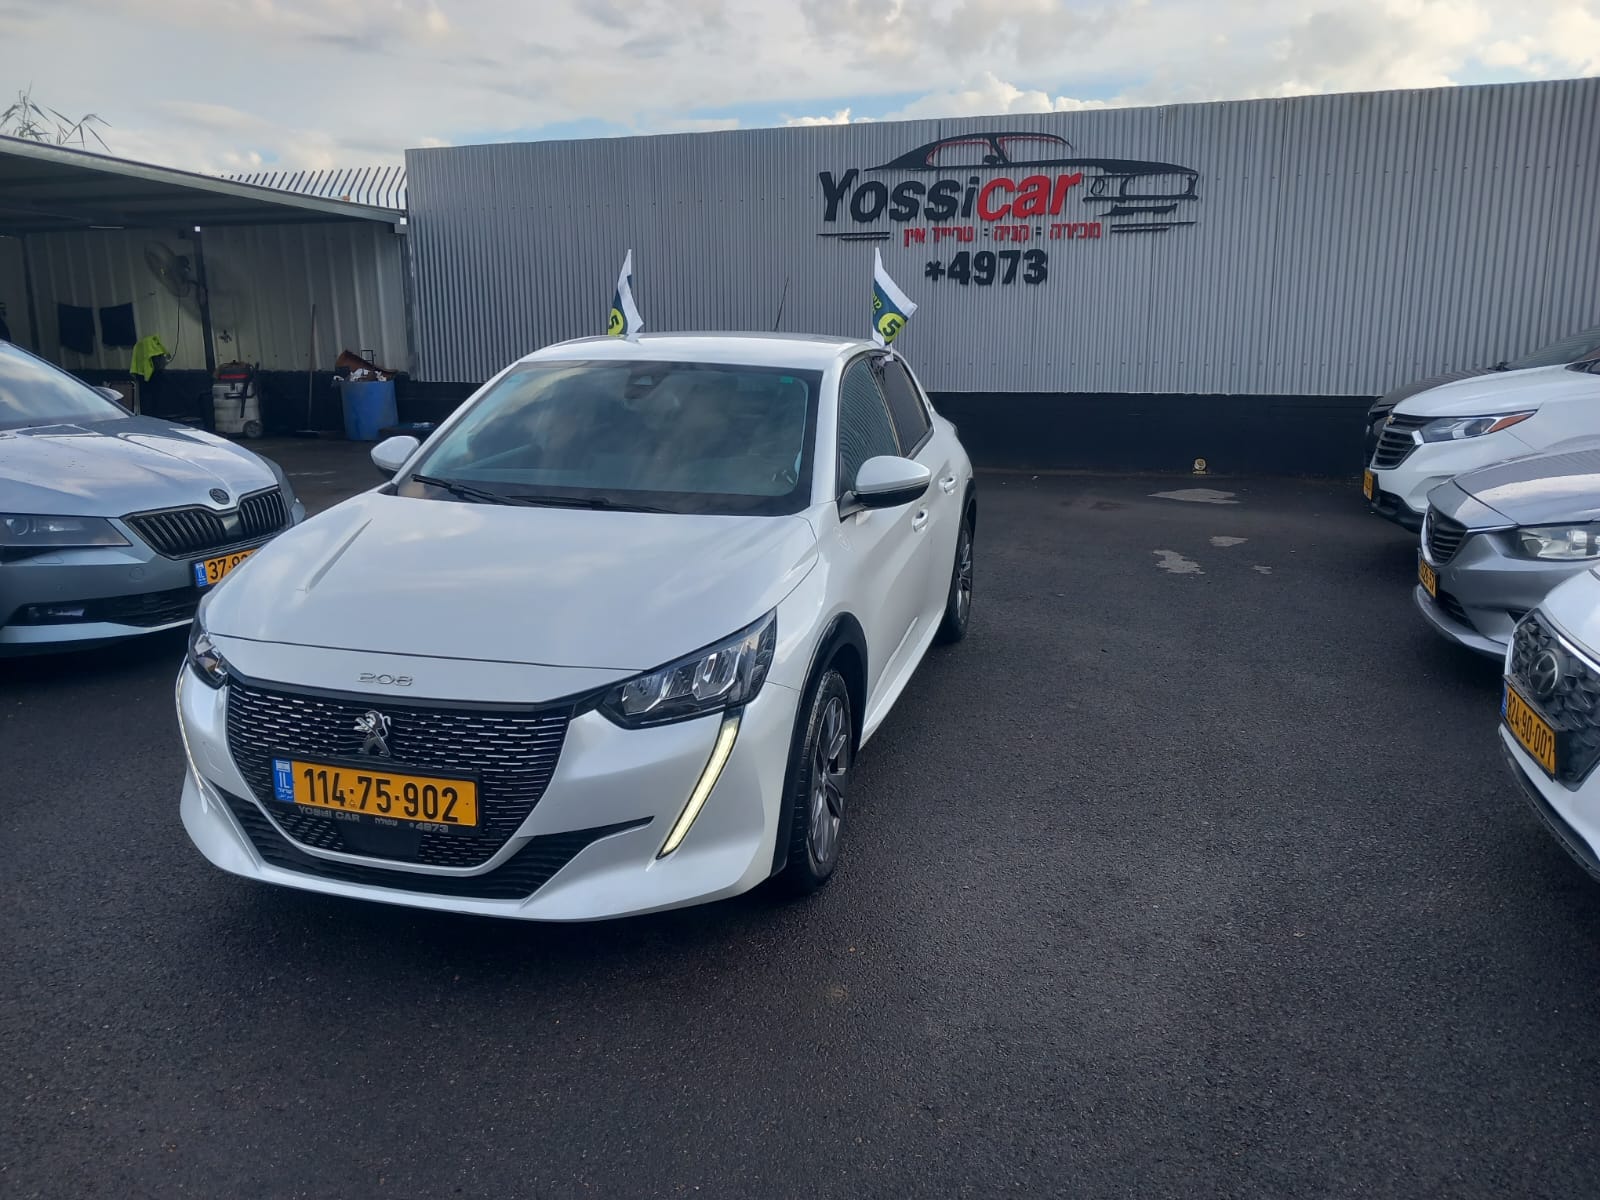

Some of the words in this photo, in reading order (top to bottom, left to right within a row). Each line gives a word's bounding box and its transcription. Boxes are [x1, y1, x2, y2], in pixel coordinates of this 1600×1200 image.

[994, 225, 1030, 243] קניה
[1050, 222, 1101, 240] מכירה
[883, 318, 901, 336] 5
[356, 672, 414, 687] 208
[279, 771, 291, 788] IL
[335, 811, 361, 823] CAR
